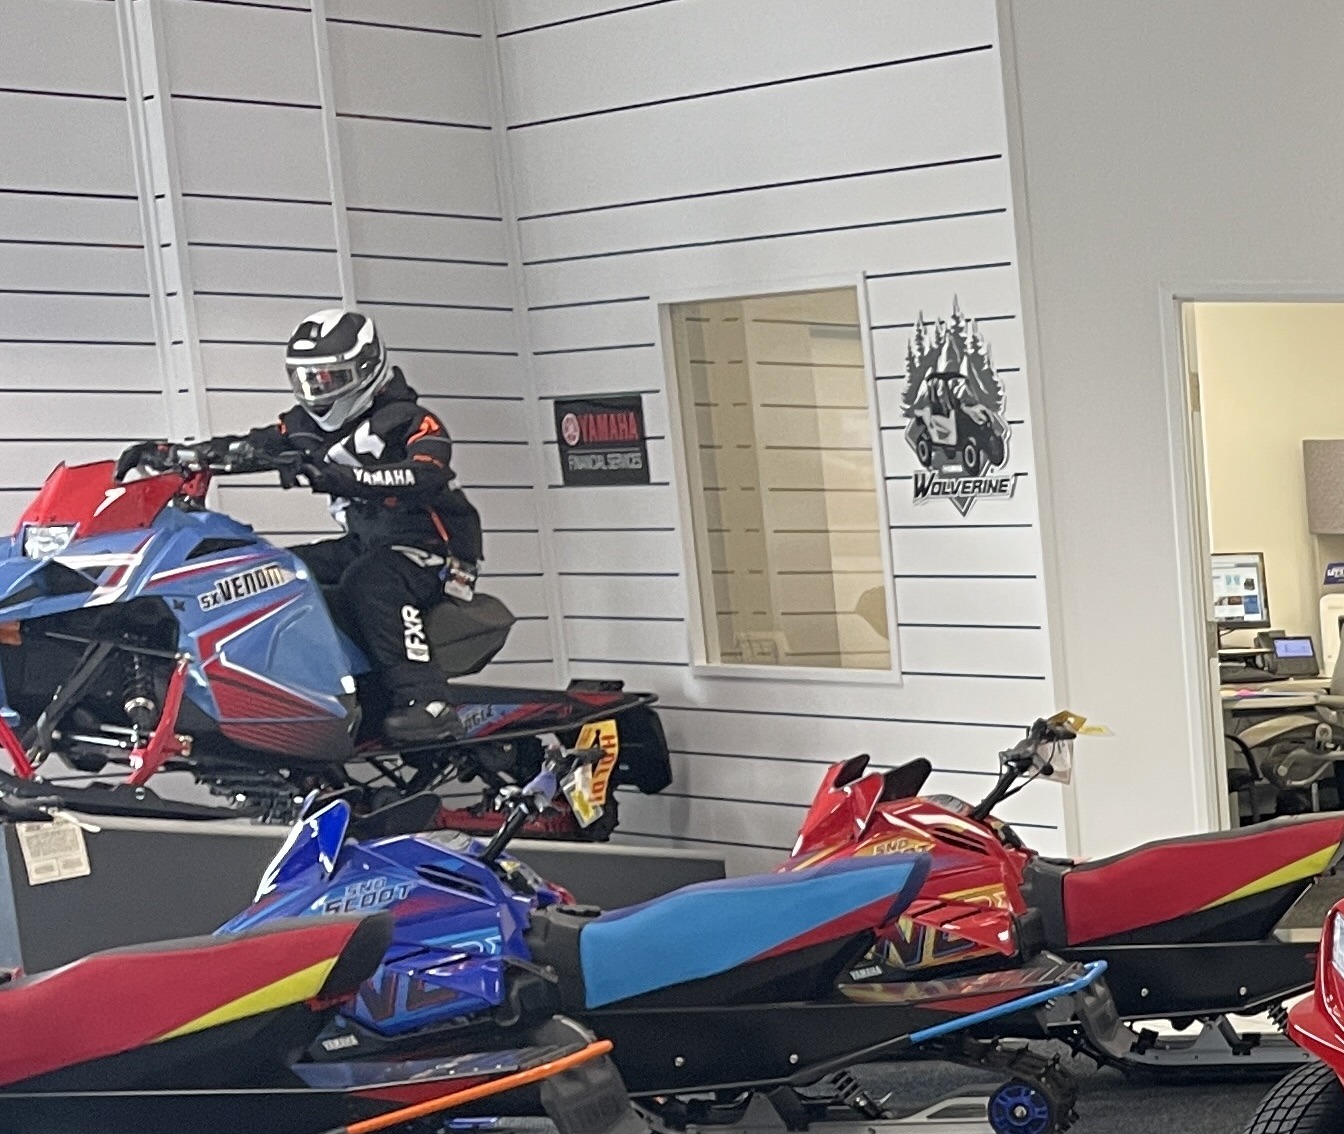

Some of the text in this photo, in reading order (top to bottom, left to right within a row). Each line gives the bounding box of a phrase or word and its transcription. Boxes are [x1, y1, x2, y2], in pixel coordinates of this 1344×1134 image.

[578, 411, 639, 443] YAMAHA
[353, 468, 416, 485] YAMAHA
[913, 473, 1011, 498] WOLVERINE
[402, 604, 430, 662] FXR
[324, 884, 412, 914] SCOOT
